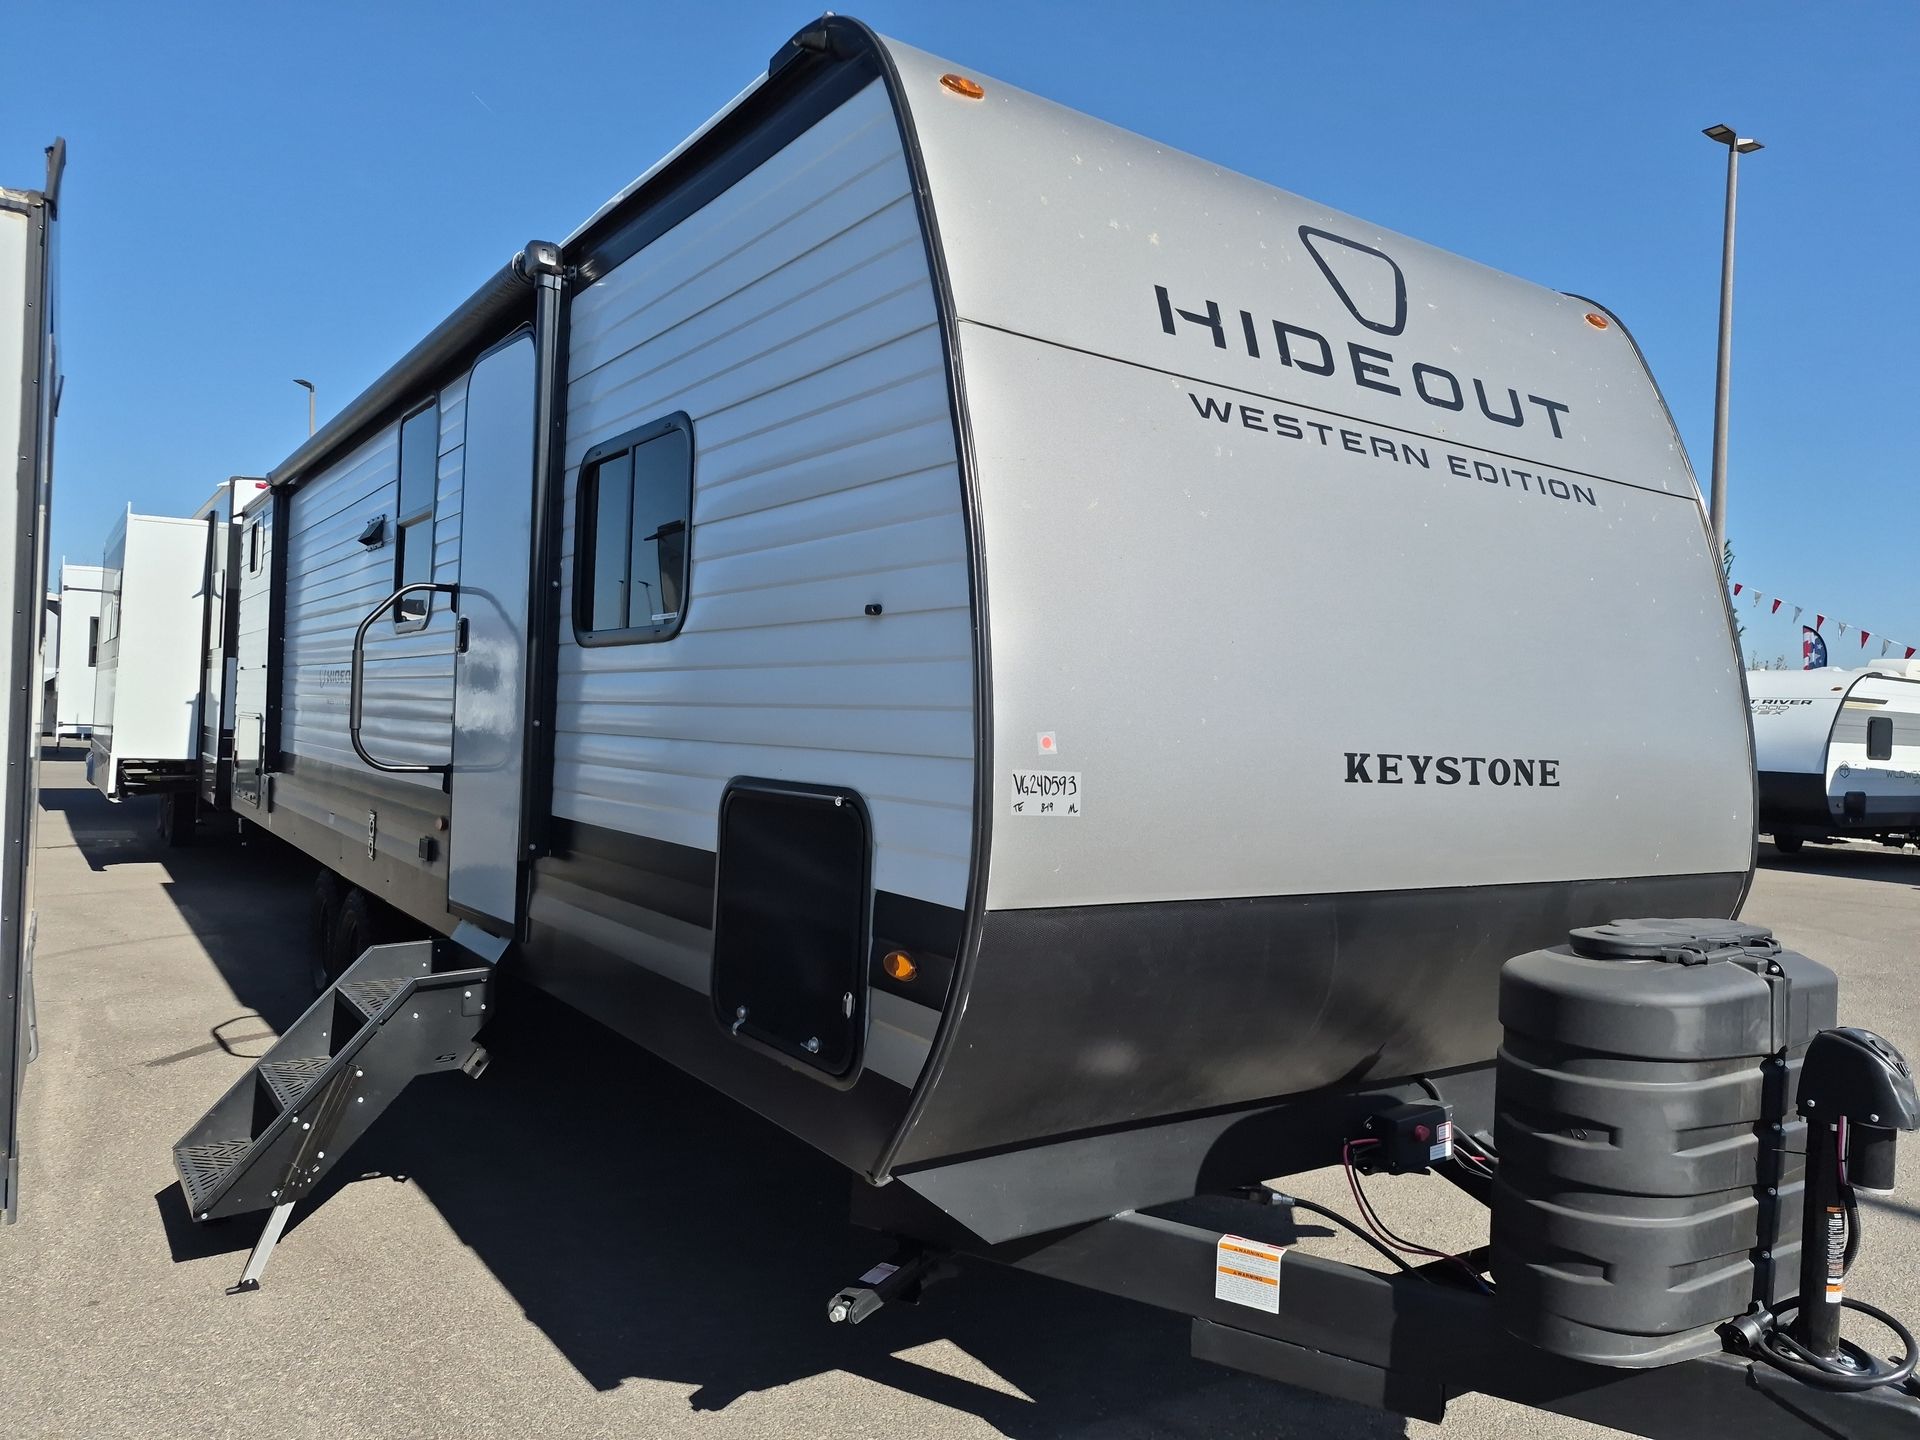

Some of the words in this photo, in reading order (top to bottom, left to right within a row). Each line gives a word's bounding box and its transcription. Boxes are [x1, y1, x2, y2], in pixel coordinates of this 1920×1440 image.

[1154, 284, 1569, 440] HIDEOUT
[1188, 392, 1430, 470] WESTERN
[1447, 453, 1598, 507] EDITION
[1344, 752, 1560, 788] KEYSTONE
[1013, 774, 1077, 796] VG240593
[1238, 1247, 1265, 1258] WARNING
[1237, 1270, 1264, 1282] WARNING
